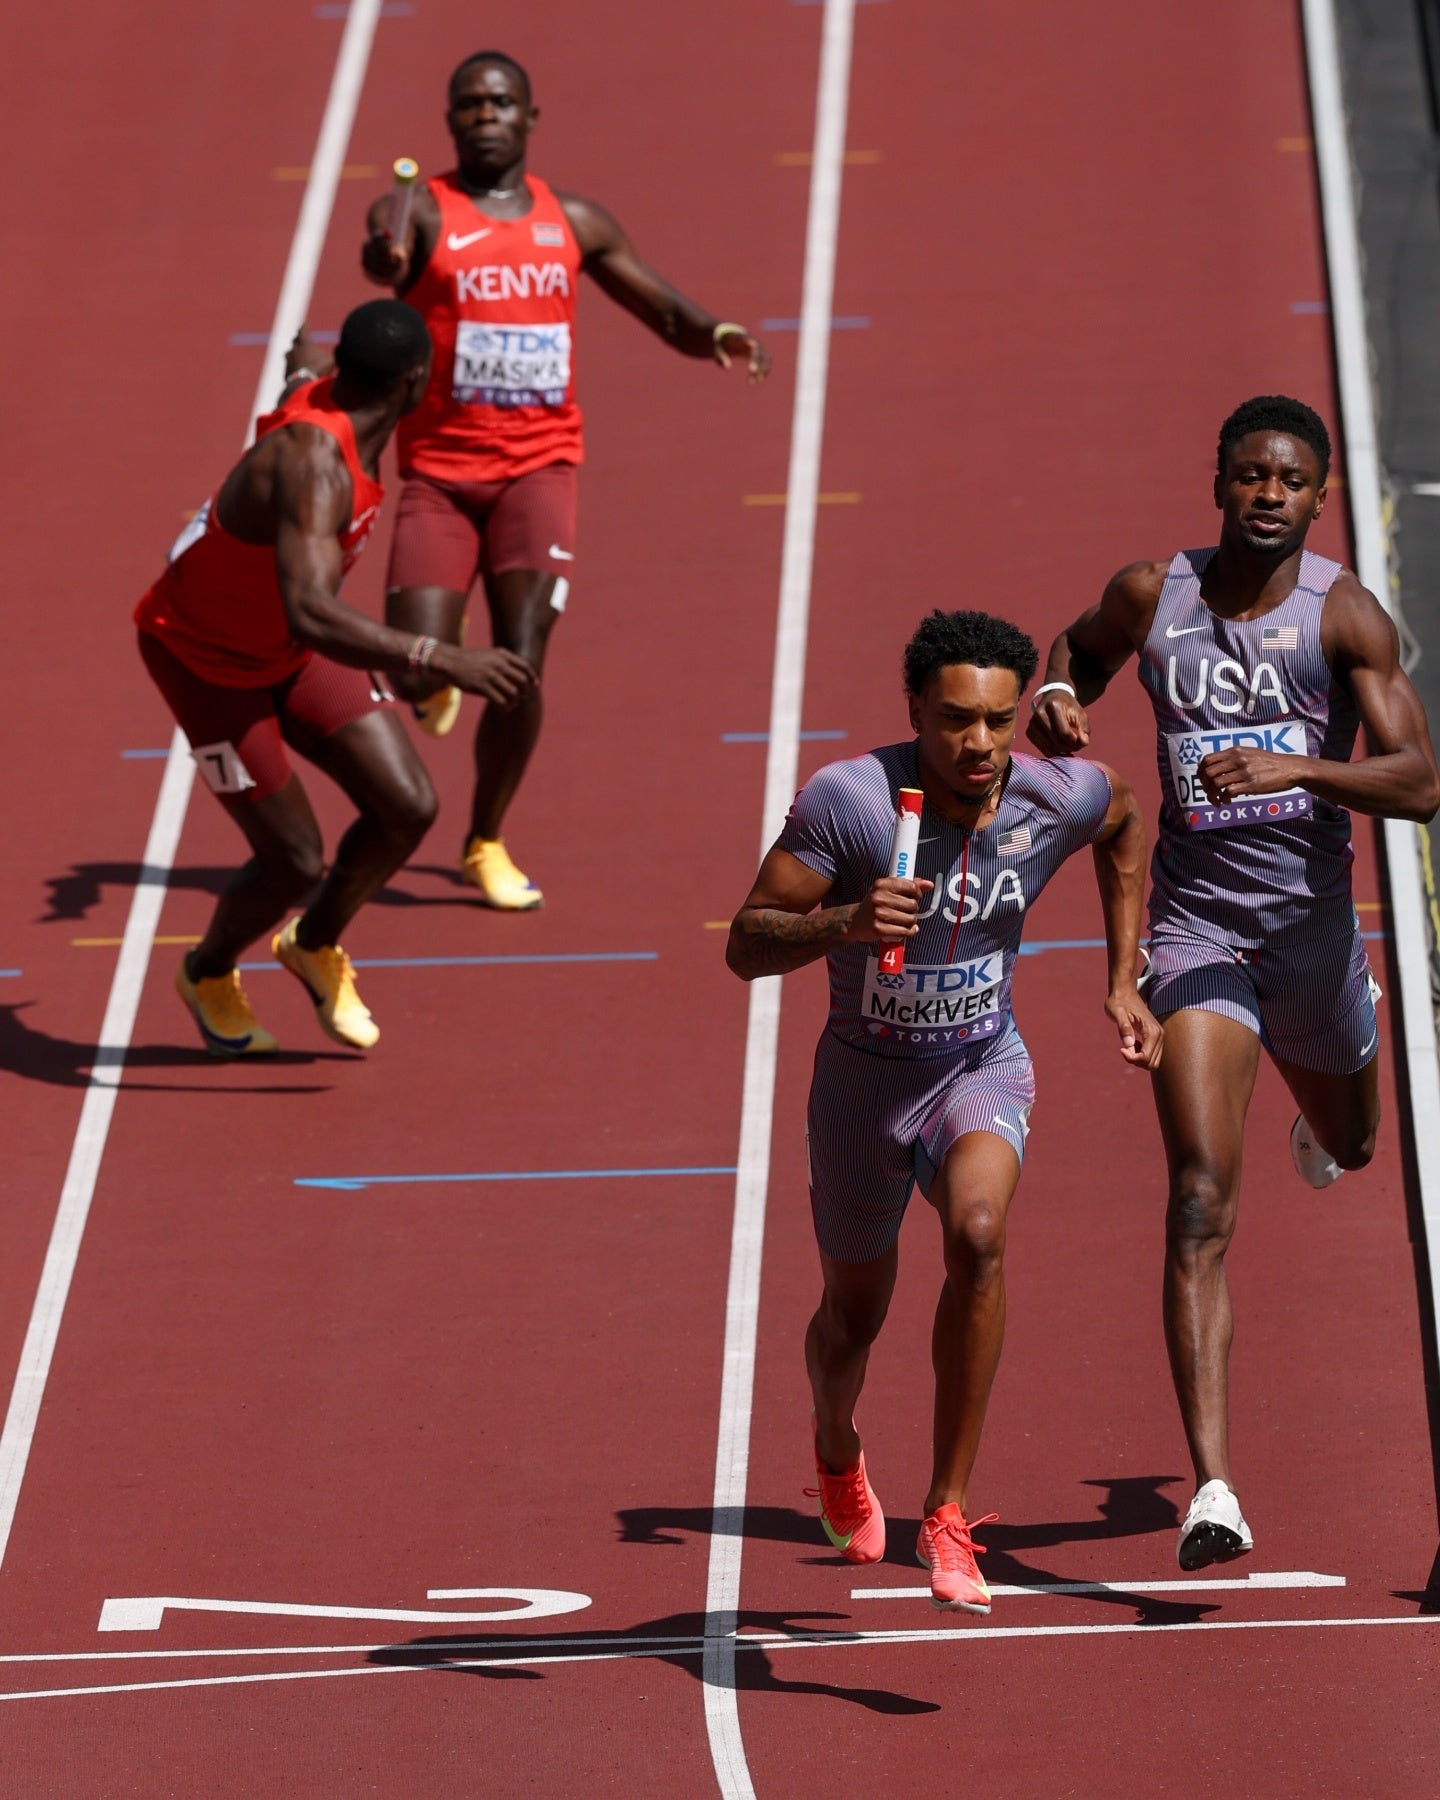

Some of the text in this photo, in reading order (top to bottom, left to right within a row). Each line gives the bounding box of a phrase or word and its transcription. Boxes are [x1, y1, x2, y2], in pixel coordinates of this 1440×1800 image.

[456, 262, 569, 303] KENYA
[493, 330, 561, 353] TDK
[463, 358, 563, 382] MASIKA
[1168, 656, 1290, 714] USA
[205, 754, 226, 784] 7
[883, 951, 896, 967] 4
[906, 957, 993, 993] TDK
[871, 988, 993, 1024] McKIVER
[97, 1587, 592, 1632] 2
